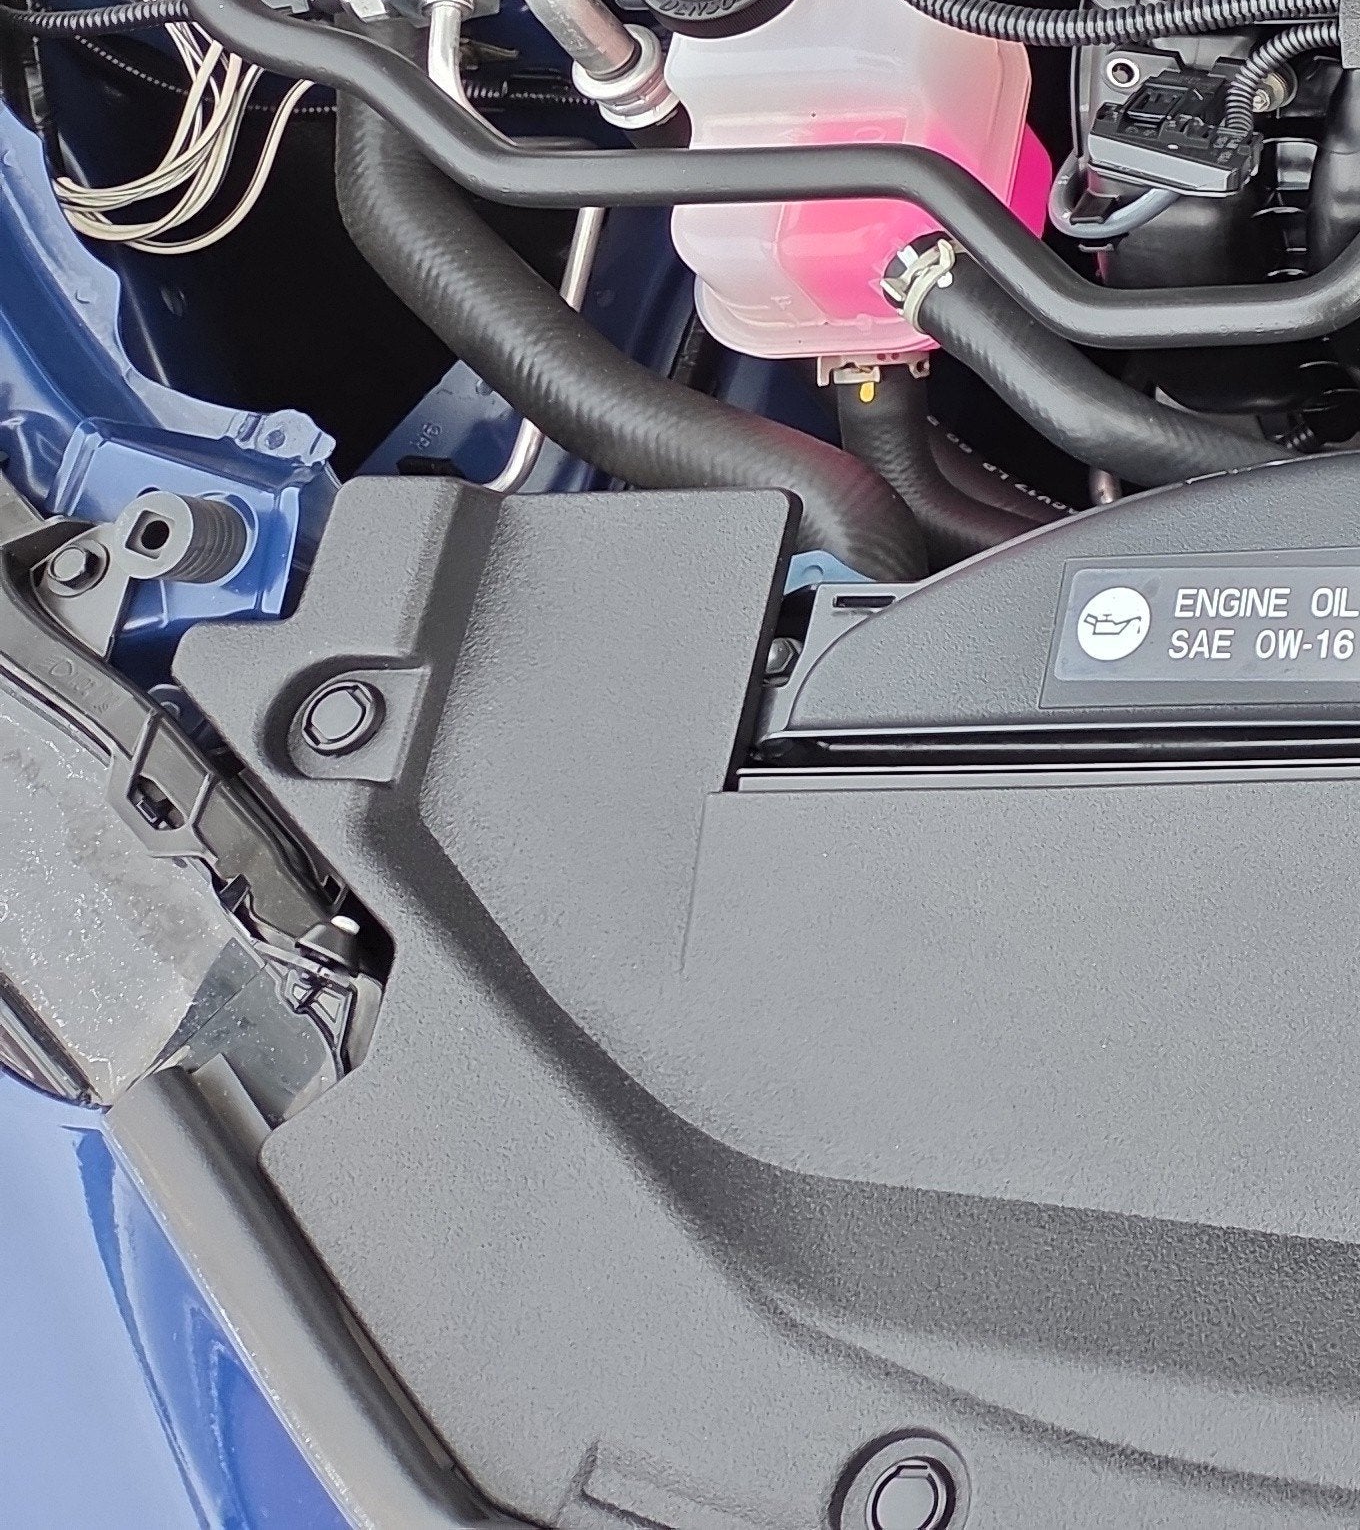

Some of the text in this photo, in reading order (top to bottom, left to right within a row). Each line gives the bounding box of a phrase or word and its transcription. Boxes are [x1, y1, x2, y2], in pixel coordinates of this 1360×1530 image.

[1174, 587, 1360, 618] ENGINE OIL
[1168, 629, 1355, 660] SAE 0W-16
